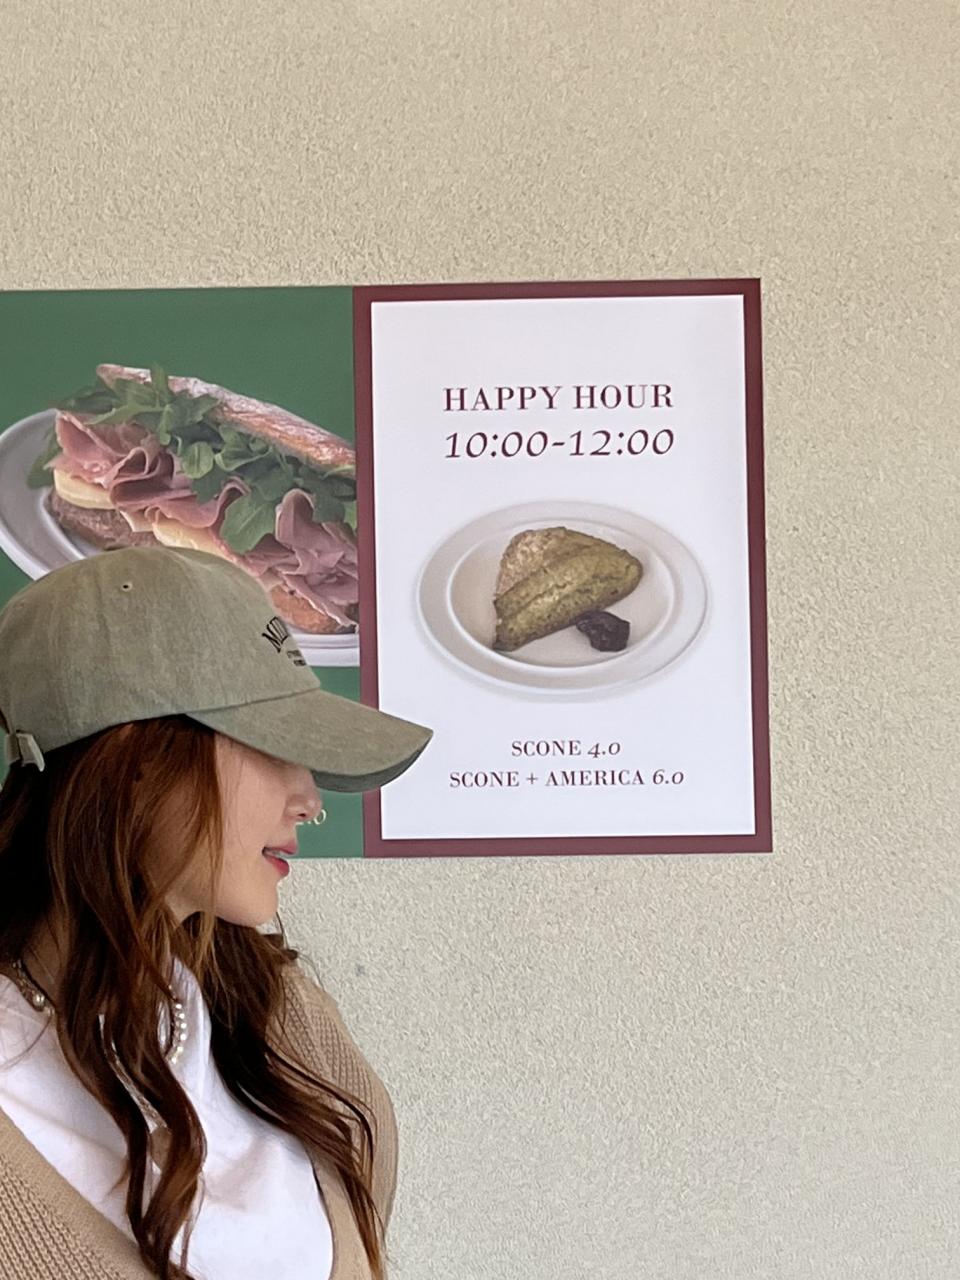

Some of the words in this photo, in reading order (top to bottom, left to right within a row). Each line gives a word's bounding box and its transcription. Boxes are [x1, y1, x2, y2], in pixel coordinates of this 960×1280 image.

[443, 386, 563, 411] HAPPY
[573, 385, 674, 408] HOUR
[446, 429, 673, 458] 10:00-12:00
[512, 741, 580, 755] SCONE
[588, 743, 620, 758] 4.0
[451, 772, 518, 786] SCONE
[527, 774, 537, 784] +
[545, 770, 643, 786] AMERICA
[653, 771, 683, 784] 6.0
